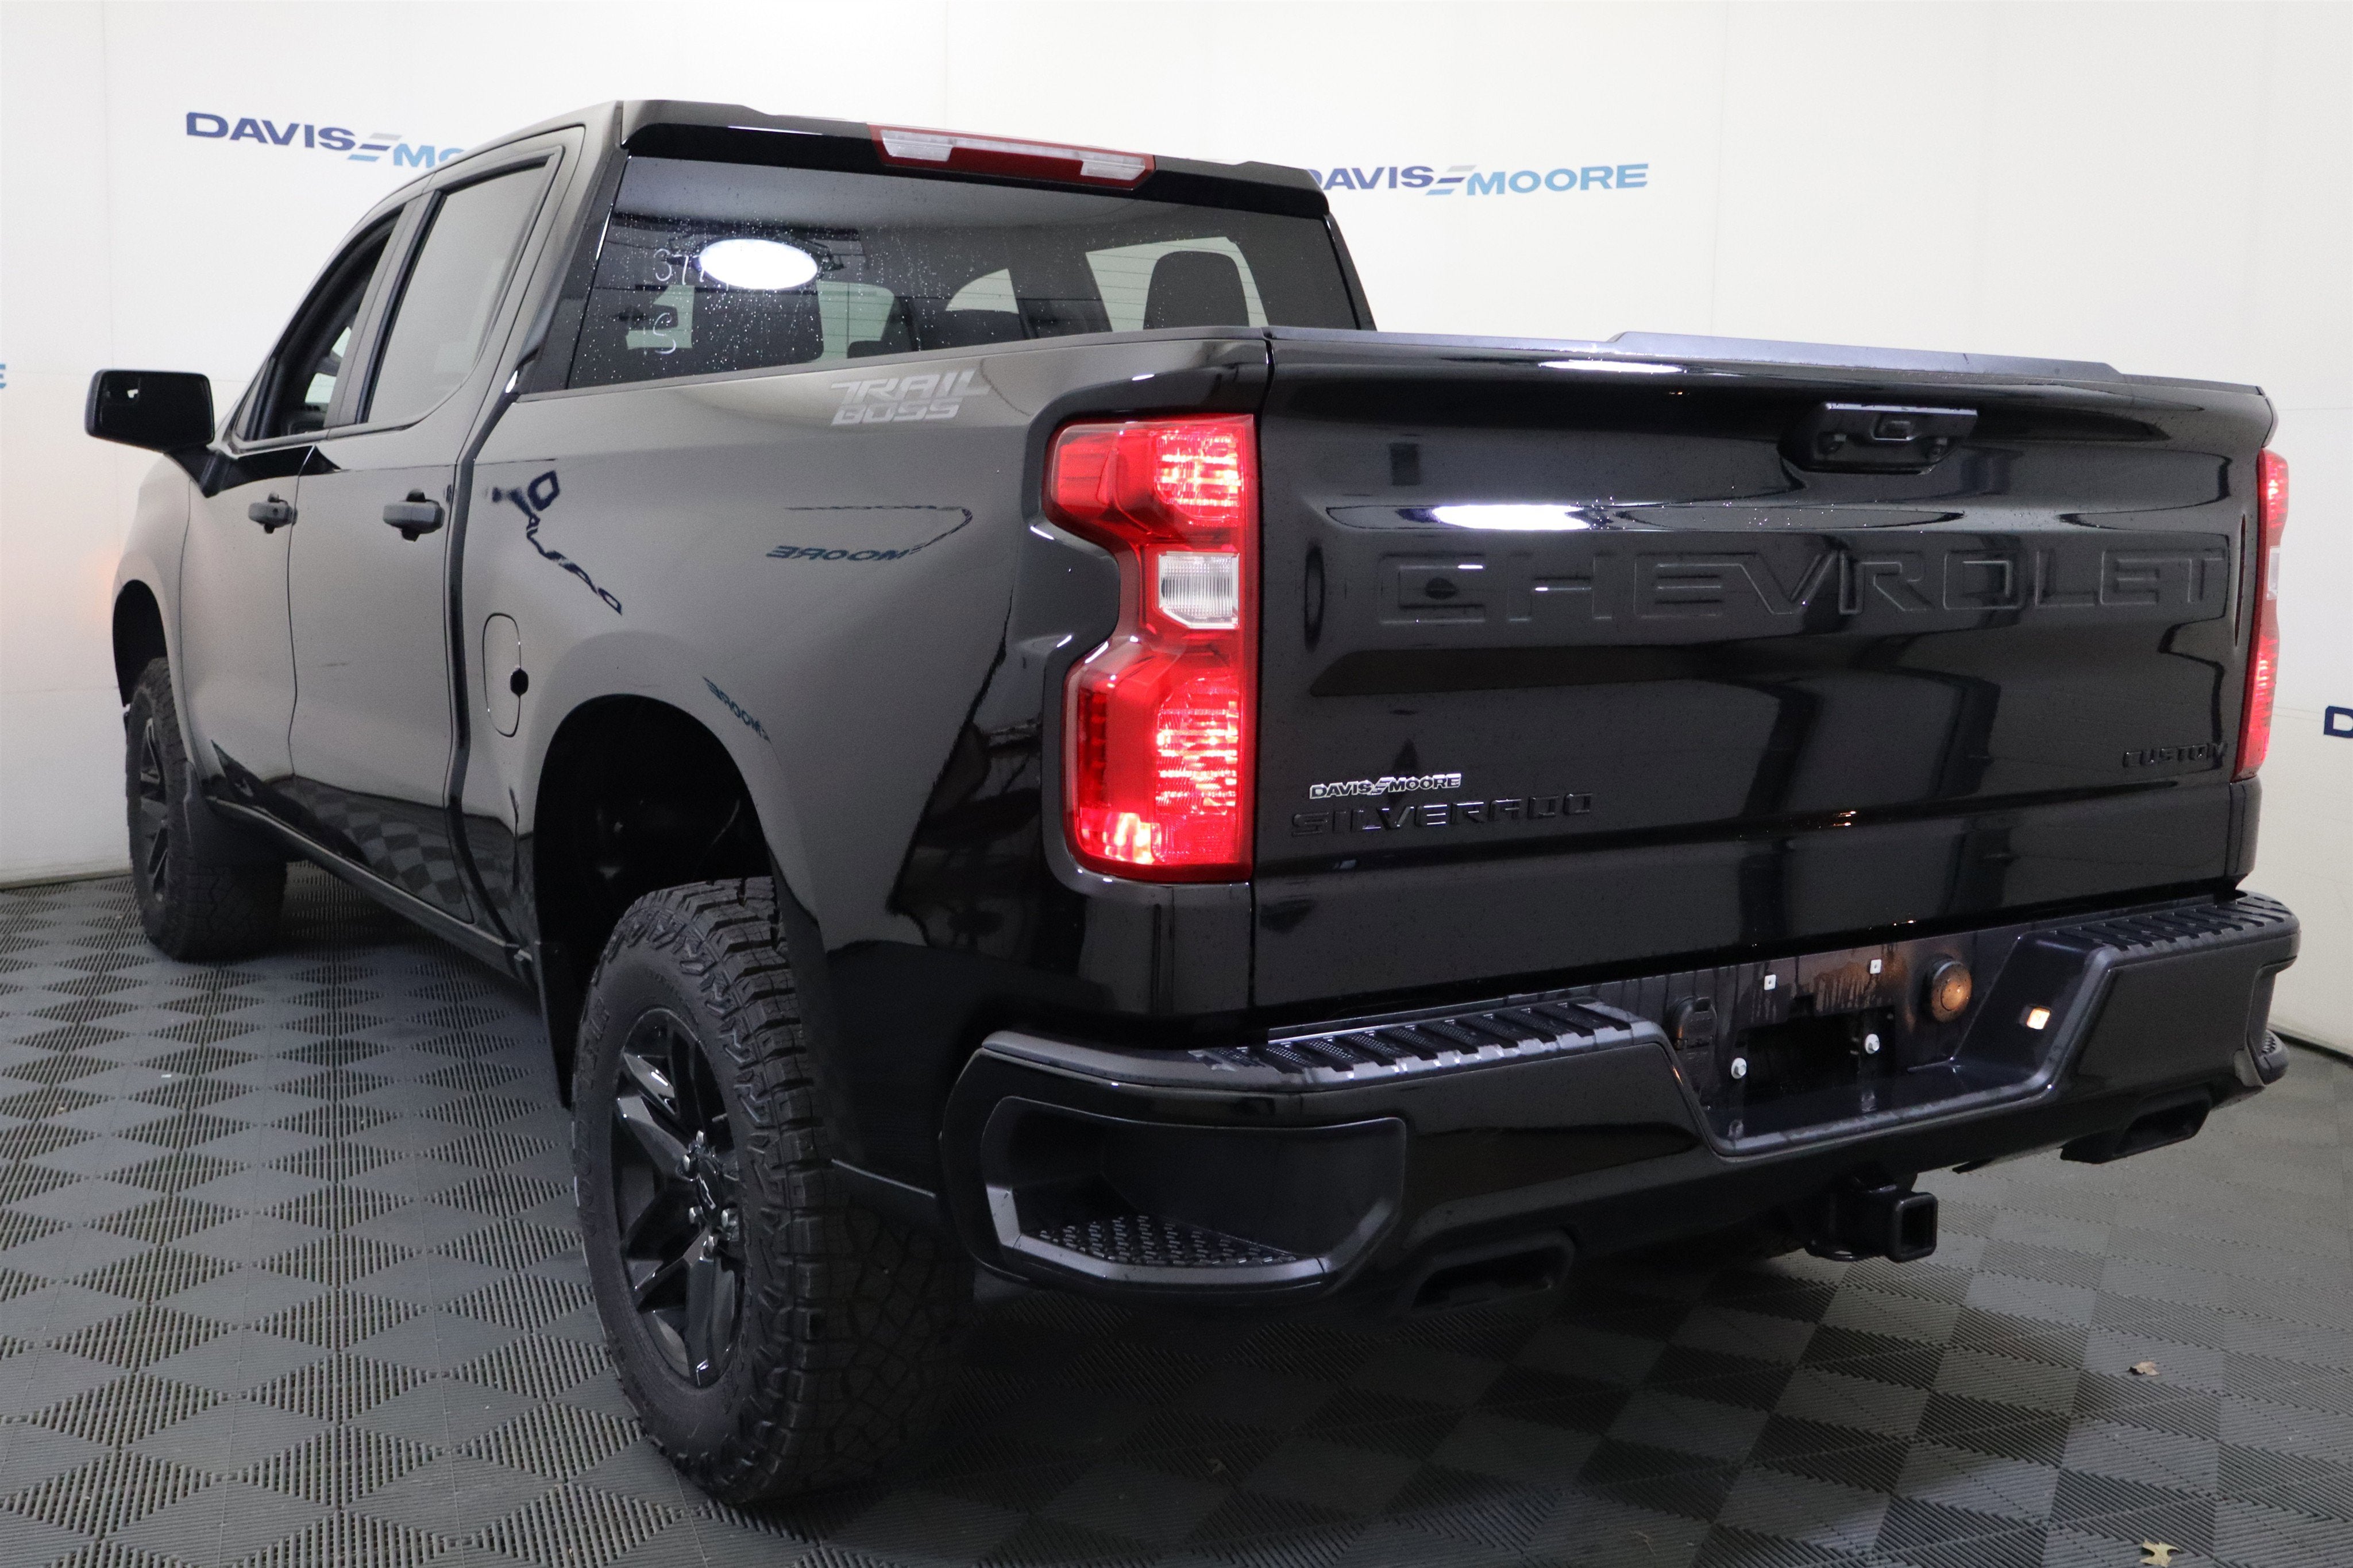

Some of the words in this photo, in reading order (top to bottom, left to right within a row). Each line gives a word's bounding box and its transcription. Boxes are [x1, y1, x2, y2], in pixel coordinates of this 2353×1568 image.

[186, 112, 356, 150] DAVIS
[1467, 164, 1648, 196] MOORE
[831, 369, 990, 404] TRAIL
[831, 398, 963, 426] BOSS
[1379, 549, 2225, 624] CHEVROLET
[2123, 742, 2228, 768] CUSTOM
[1310, 780, 1373, 799] DAVIS
[1388, 773, 1461, 793] MOORE
[1291, 793, 1594, 836] SILVERADO
